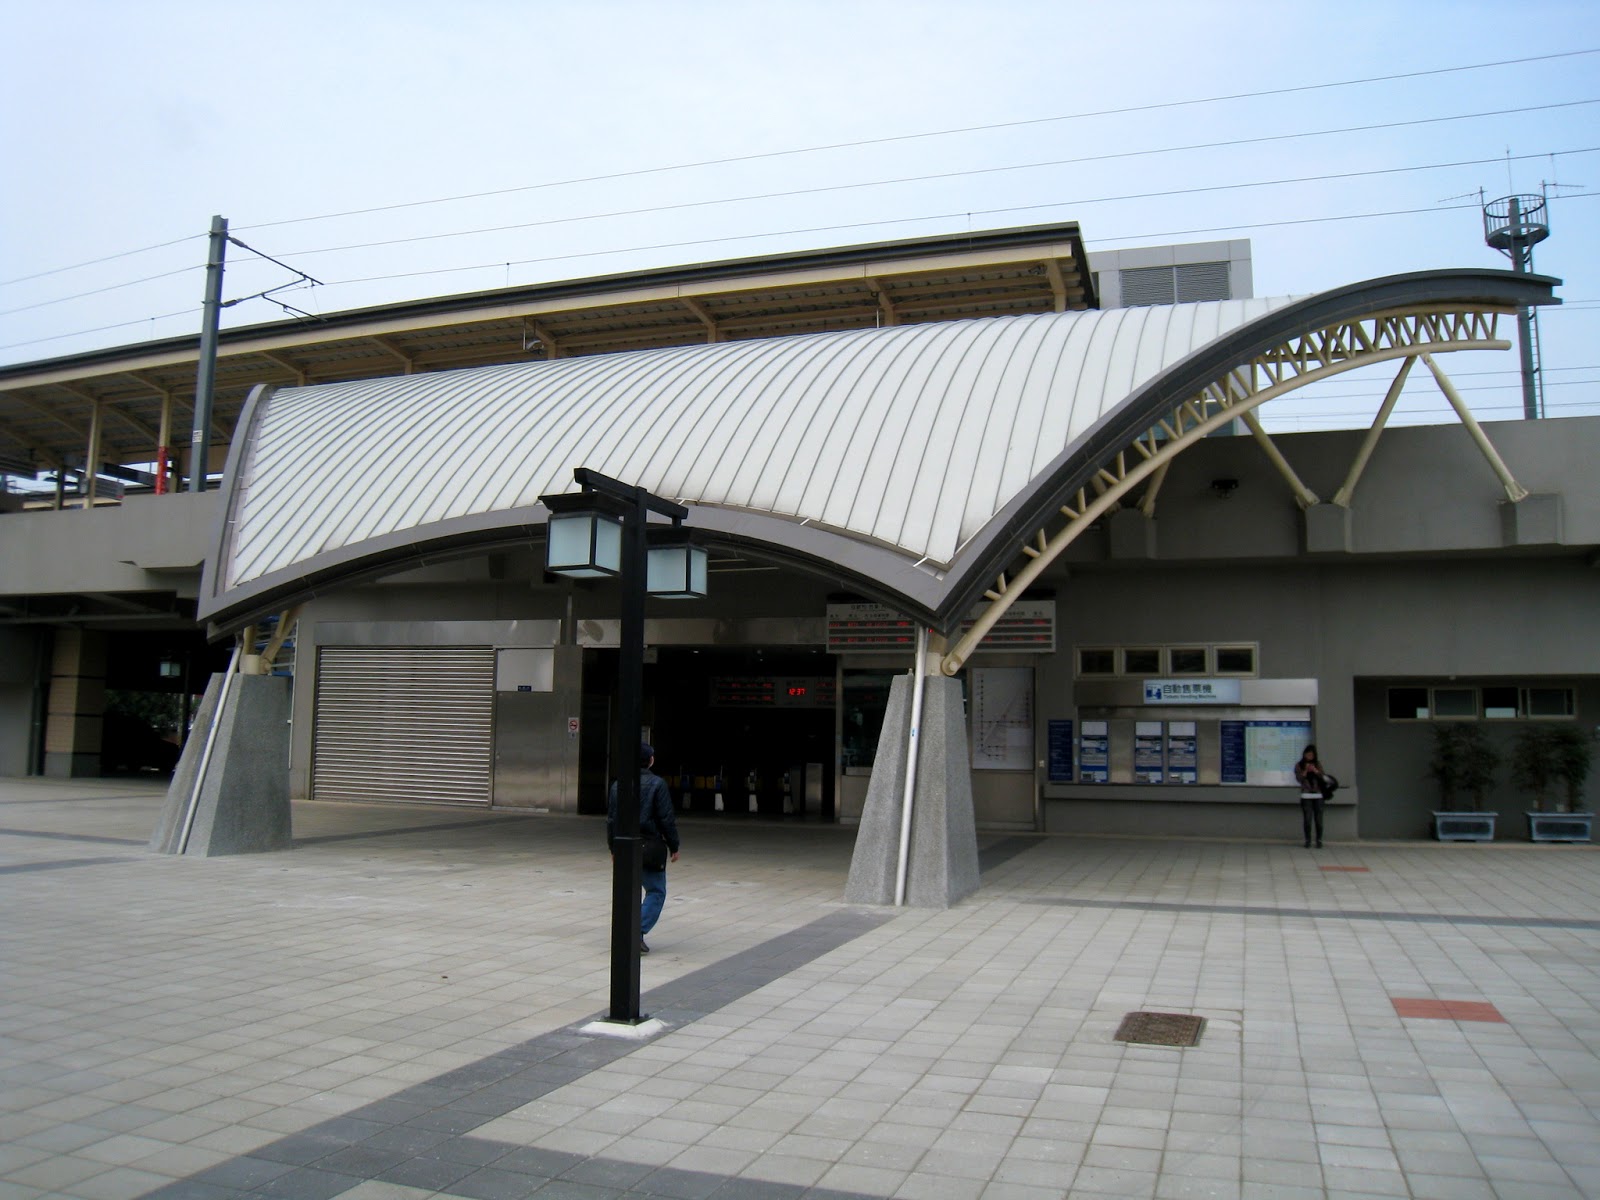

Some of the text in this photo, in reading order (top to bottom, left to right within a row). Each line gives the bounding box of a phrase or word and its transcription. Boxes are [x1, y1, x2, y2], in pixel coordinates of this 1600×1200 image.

[1163, 684, 1212, 693] 自動售票機
